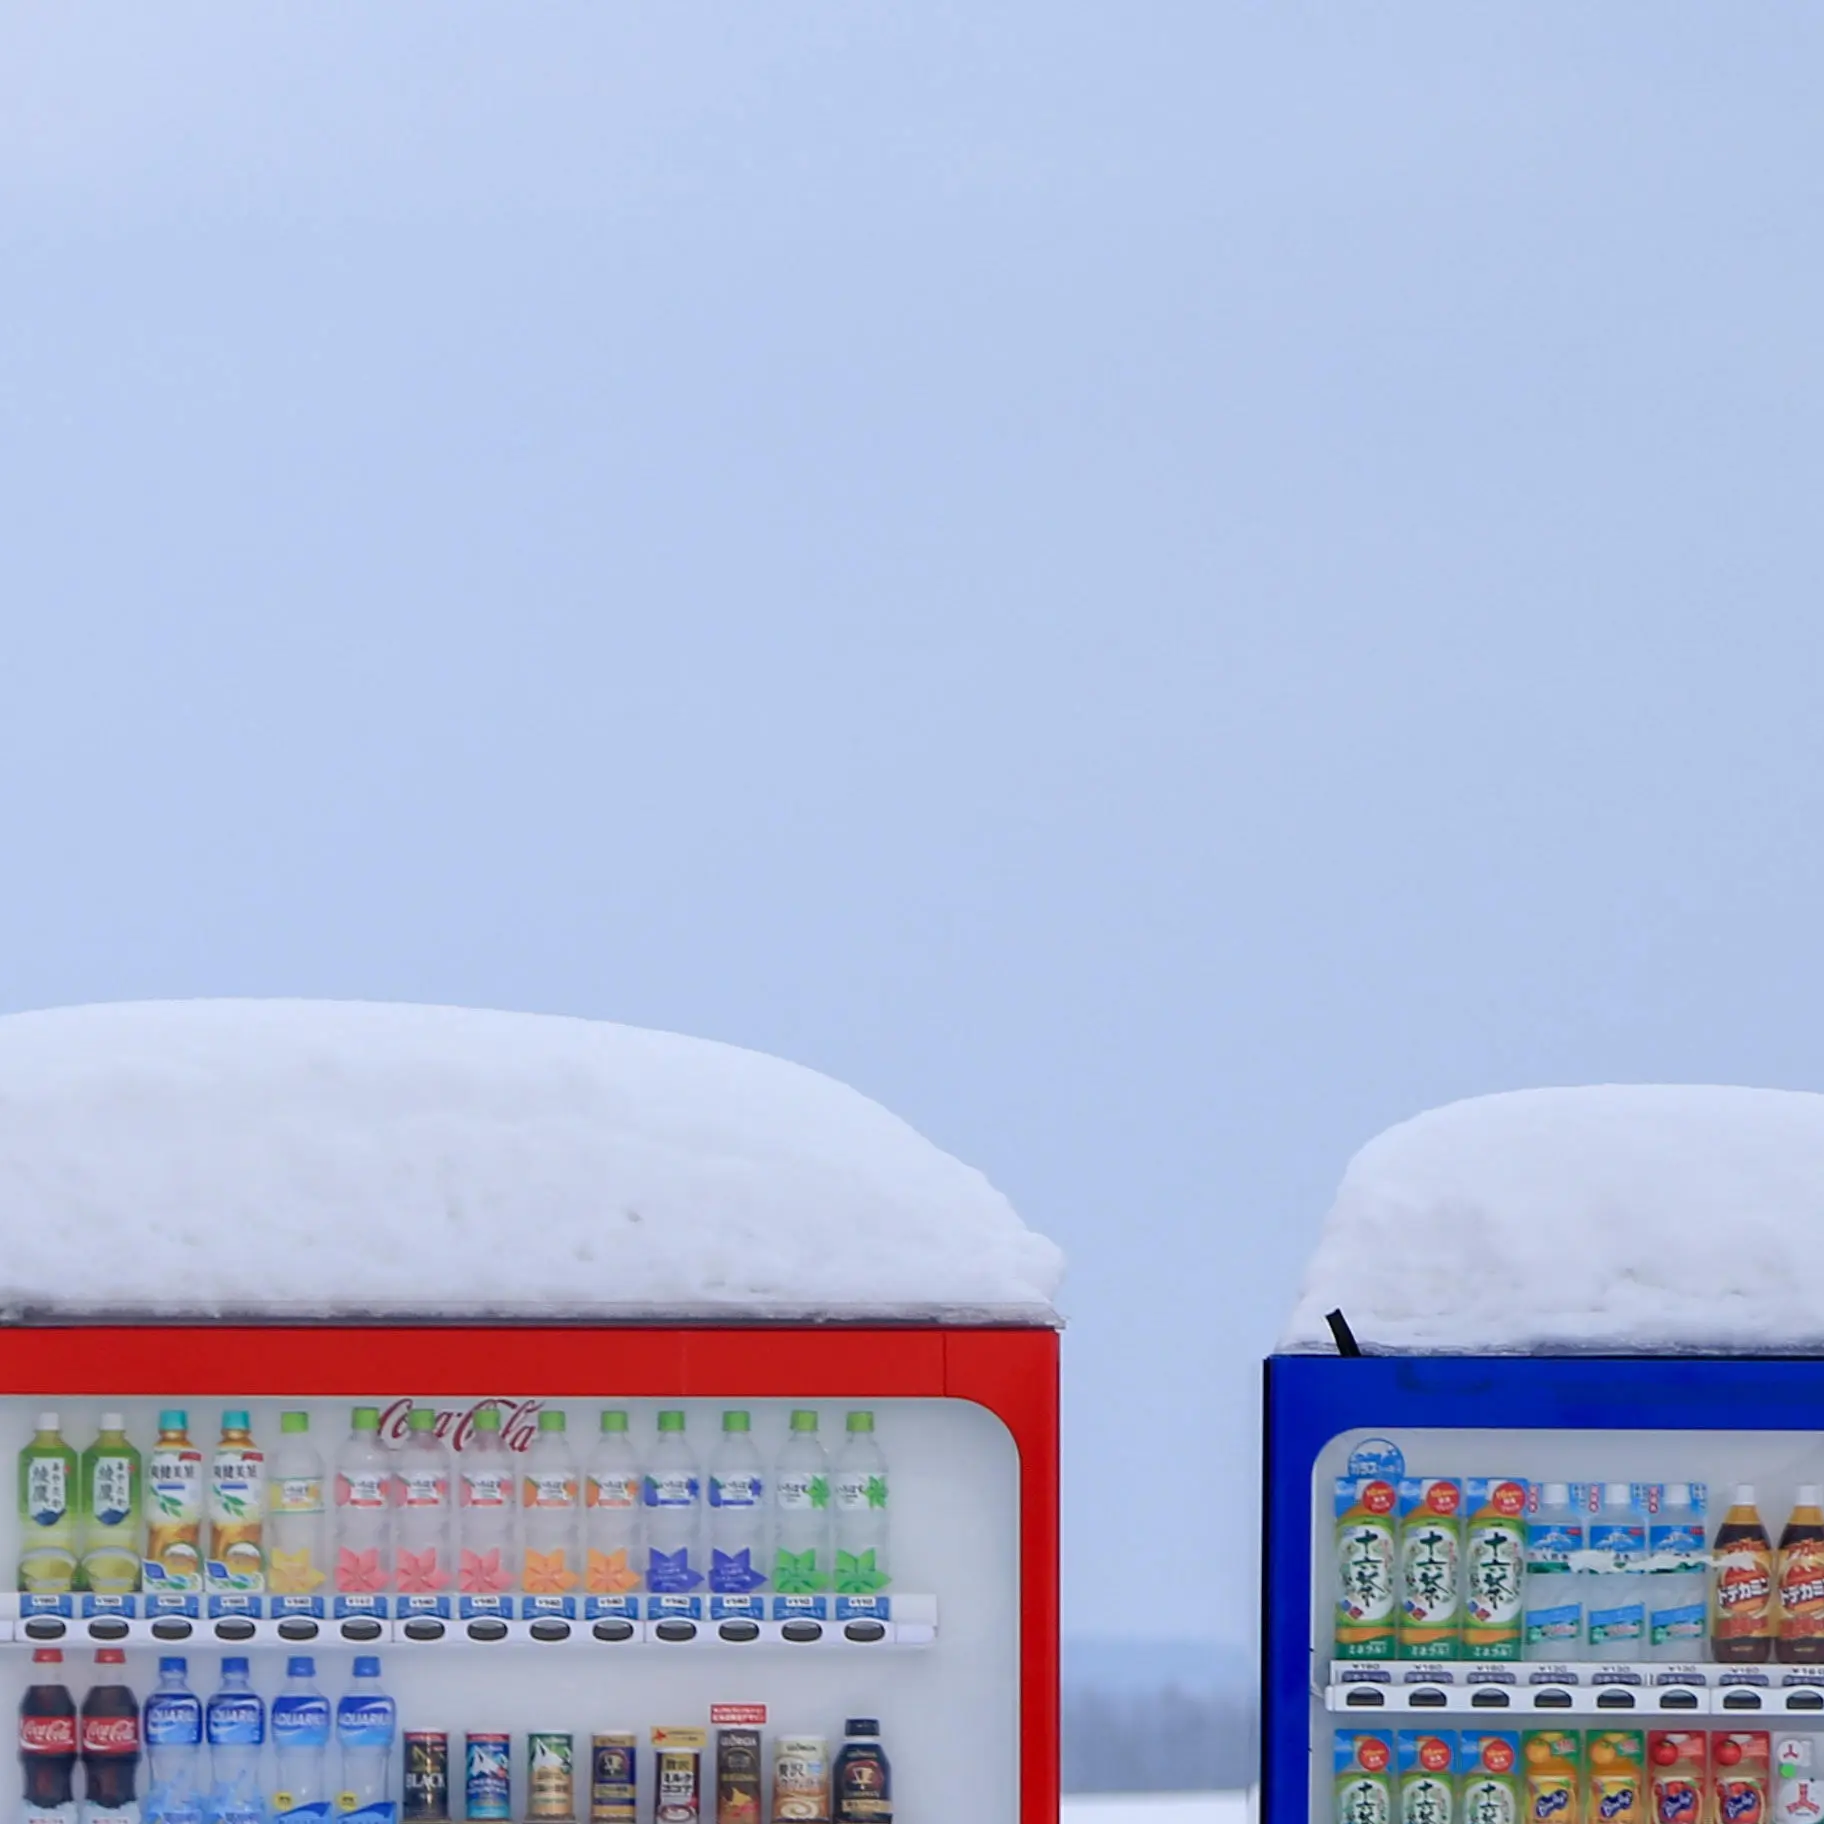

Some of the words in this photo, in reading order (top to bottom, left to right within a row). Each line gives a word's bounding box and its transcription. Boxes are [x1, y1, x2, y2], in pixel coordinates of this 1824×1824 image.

[1351, 1529, 1386, 1608] 十六茶
[1416, 1531, 1451, 1609] 十六茶
[1480, 1532, 1514, 1610] 十六茶
